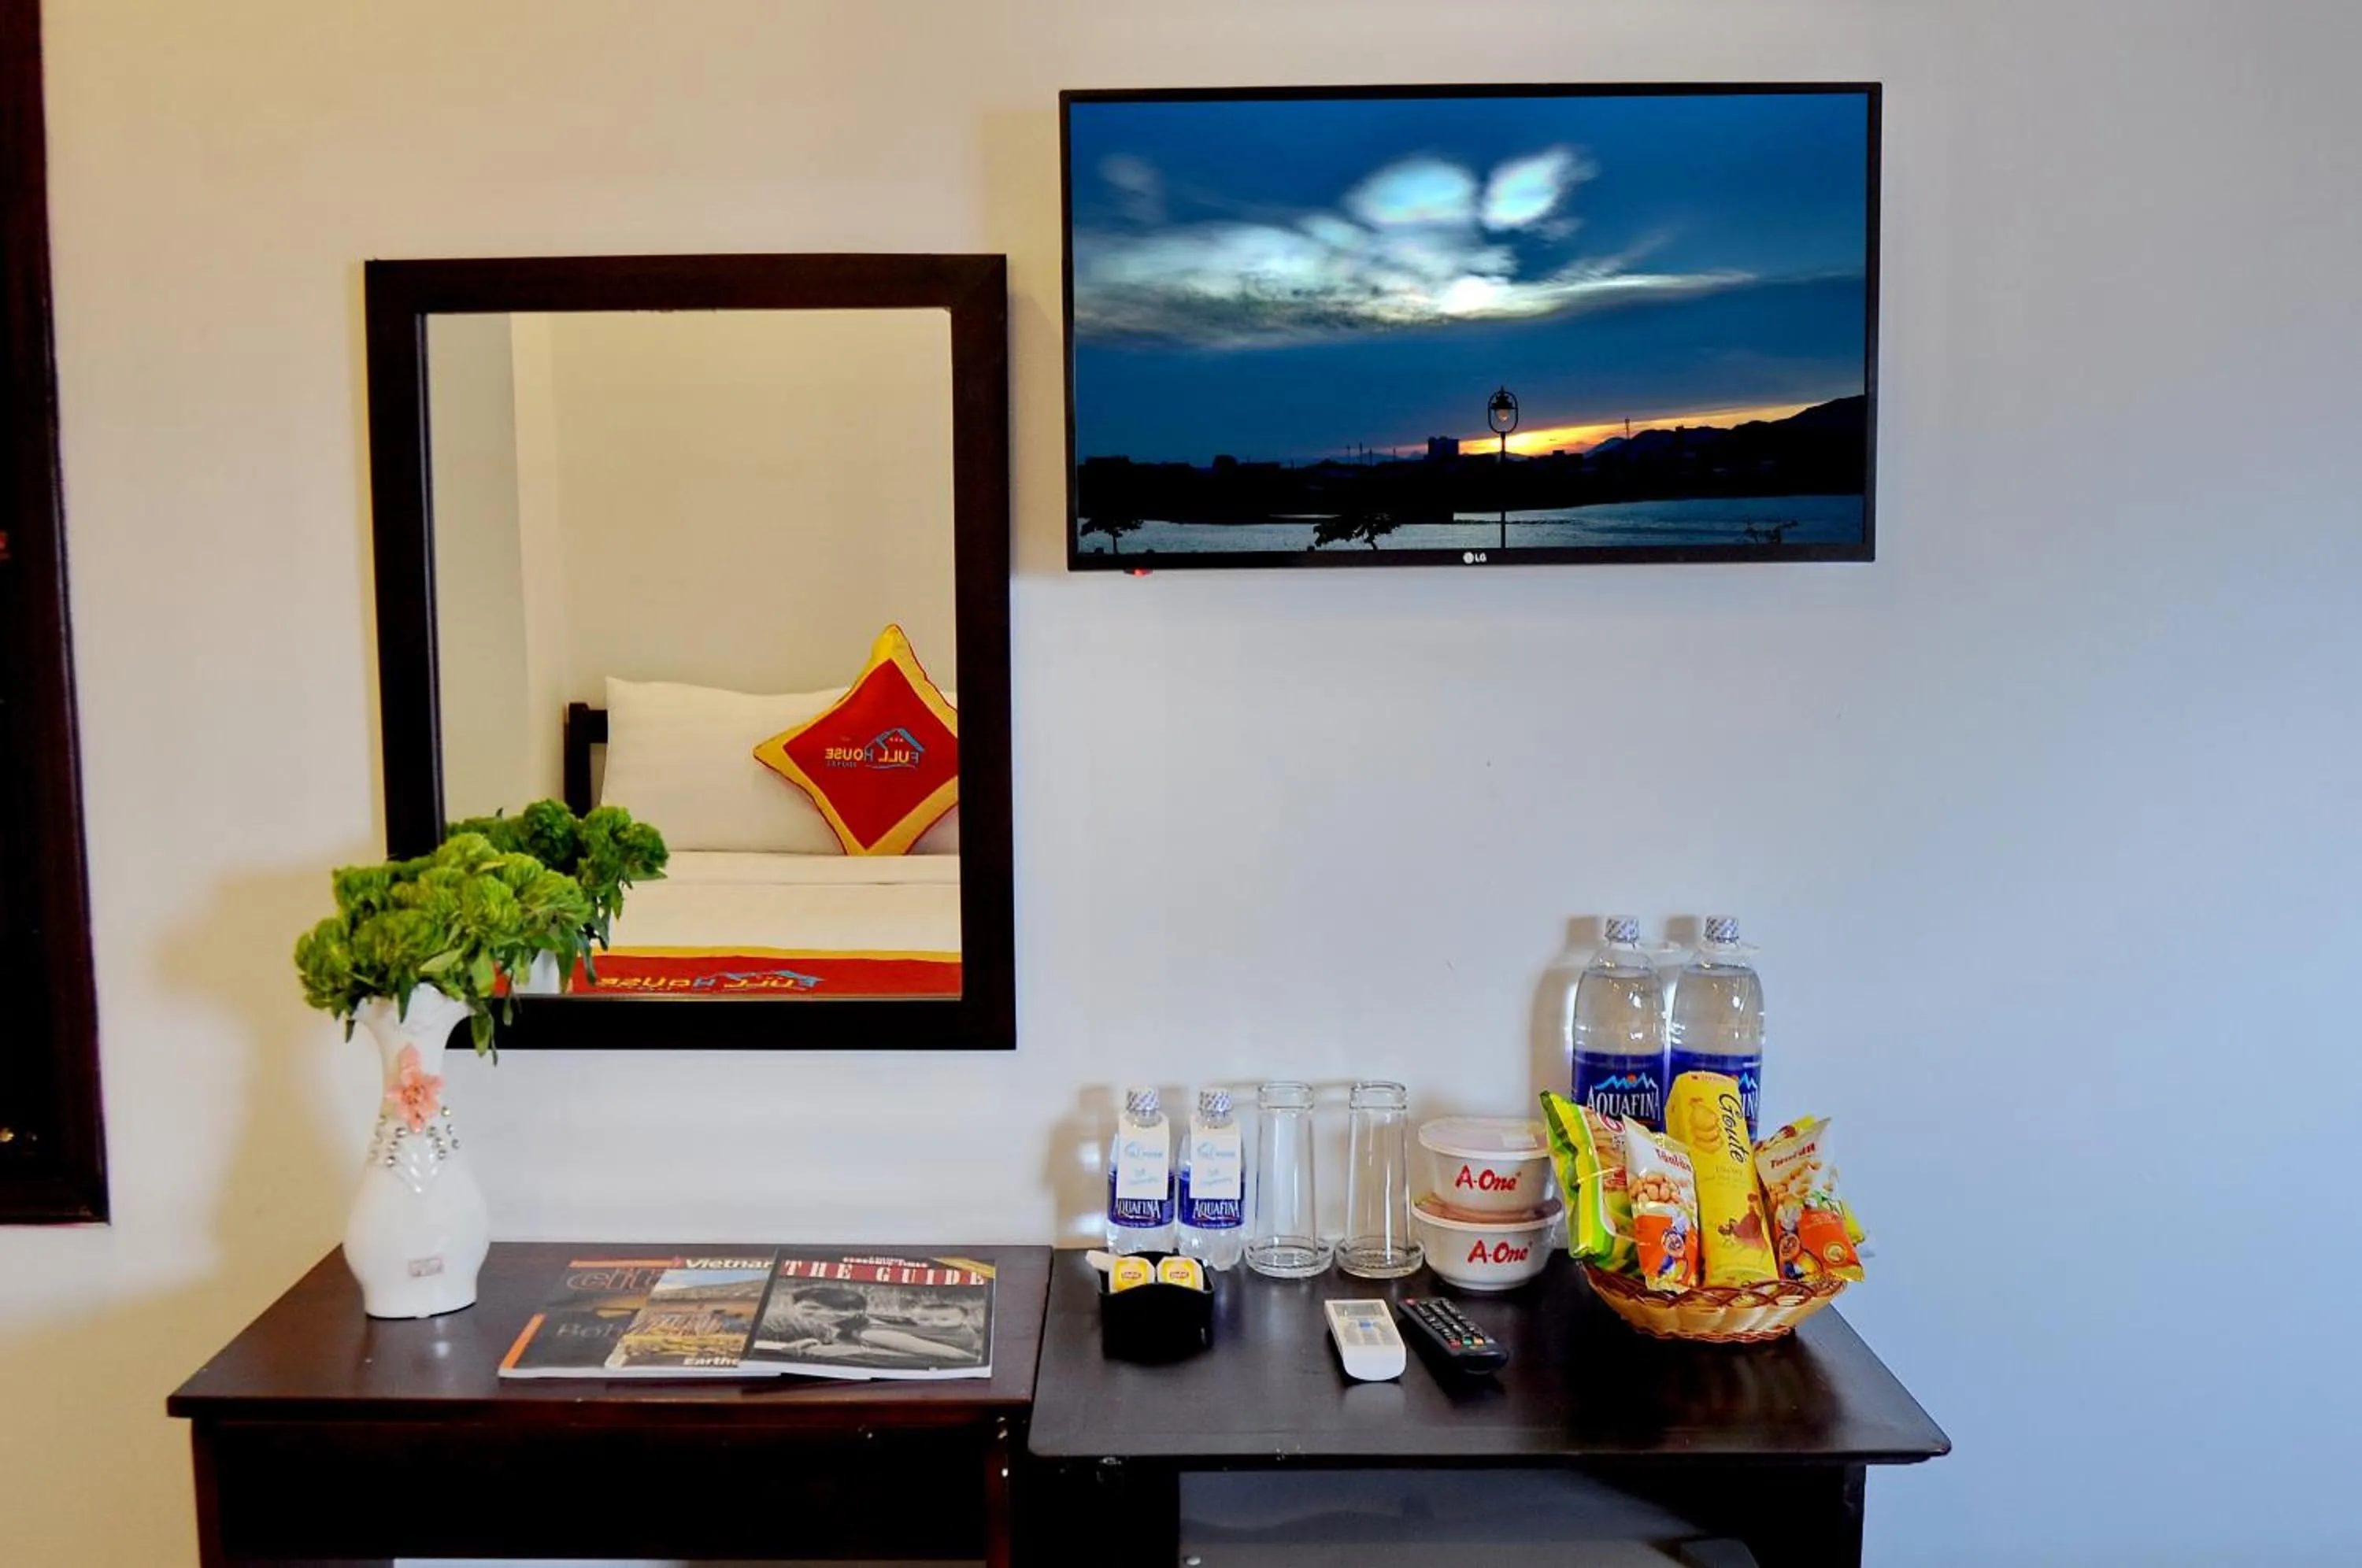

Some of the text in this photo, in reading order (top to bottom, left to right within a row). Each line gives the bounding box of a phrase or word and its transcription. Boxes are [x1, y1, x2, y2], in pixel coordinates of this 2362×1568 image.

[1586, 1085, 1661, 1122] AQUAFINA
[1455, 1165, 1518, 1191] A-One
[1117, 1198, 1161, 1219] QUAFINA
[1193, 1199, 1240, 1219] AQUAFINA
[1468, 1240, 1529, 1264] A-One
[785, 1259, 853, 1280] THE
[876, 1267, 985, 1285] GUIDE
